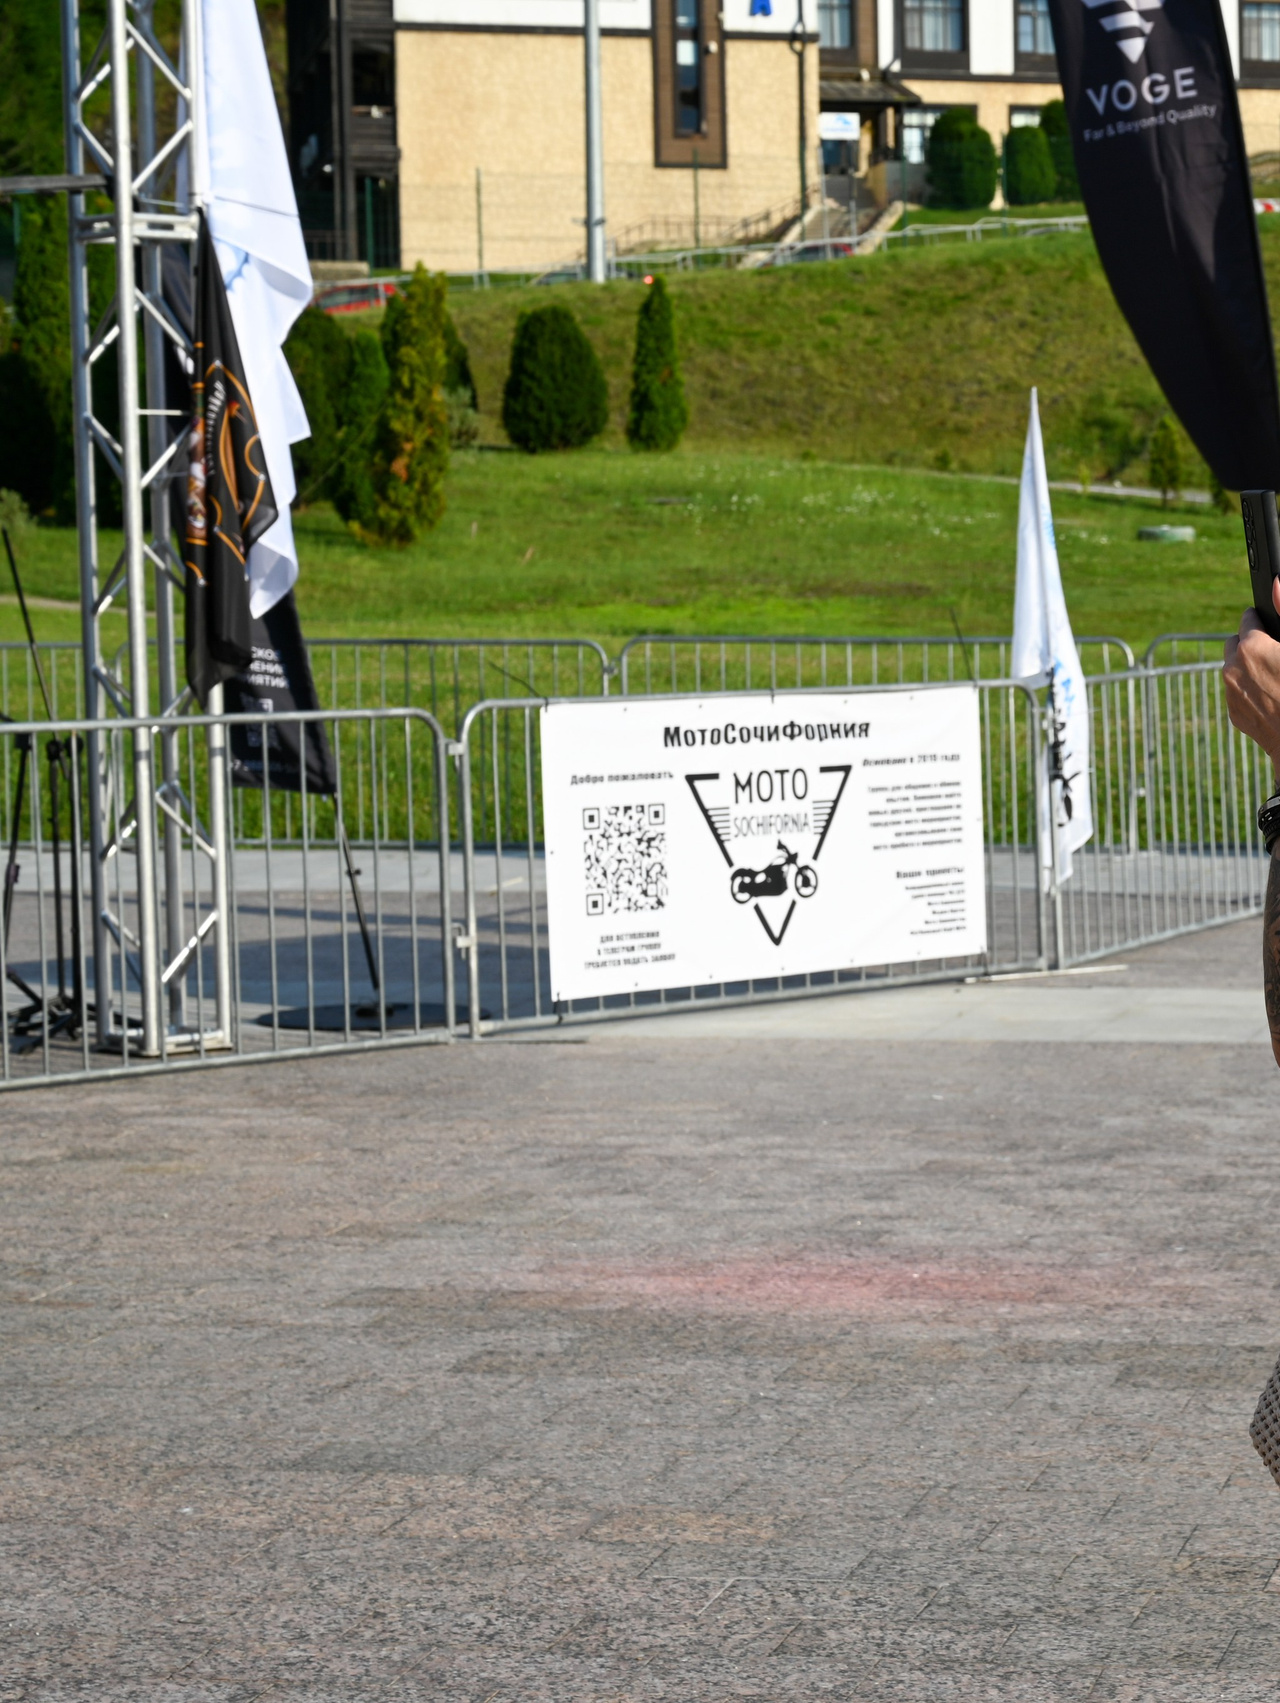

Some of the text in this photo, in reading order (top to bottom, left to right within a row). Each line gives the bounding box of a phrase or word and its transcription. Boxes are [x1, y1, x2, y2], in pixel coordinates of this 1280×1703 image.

[1086, 66, 1198, 116] VOGE
[1083, 128, 1104, 142] Far
[1116, 111, 1165, 134] Beyond
[1166, 104, 1217, 125] Quality
[664, 721, 870, 748] МотоСочиФорния
[733, 768, 808, 804] MOTO
[733, 813, 811, 838] SOCHIFORNIA
